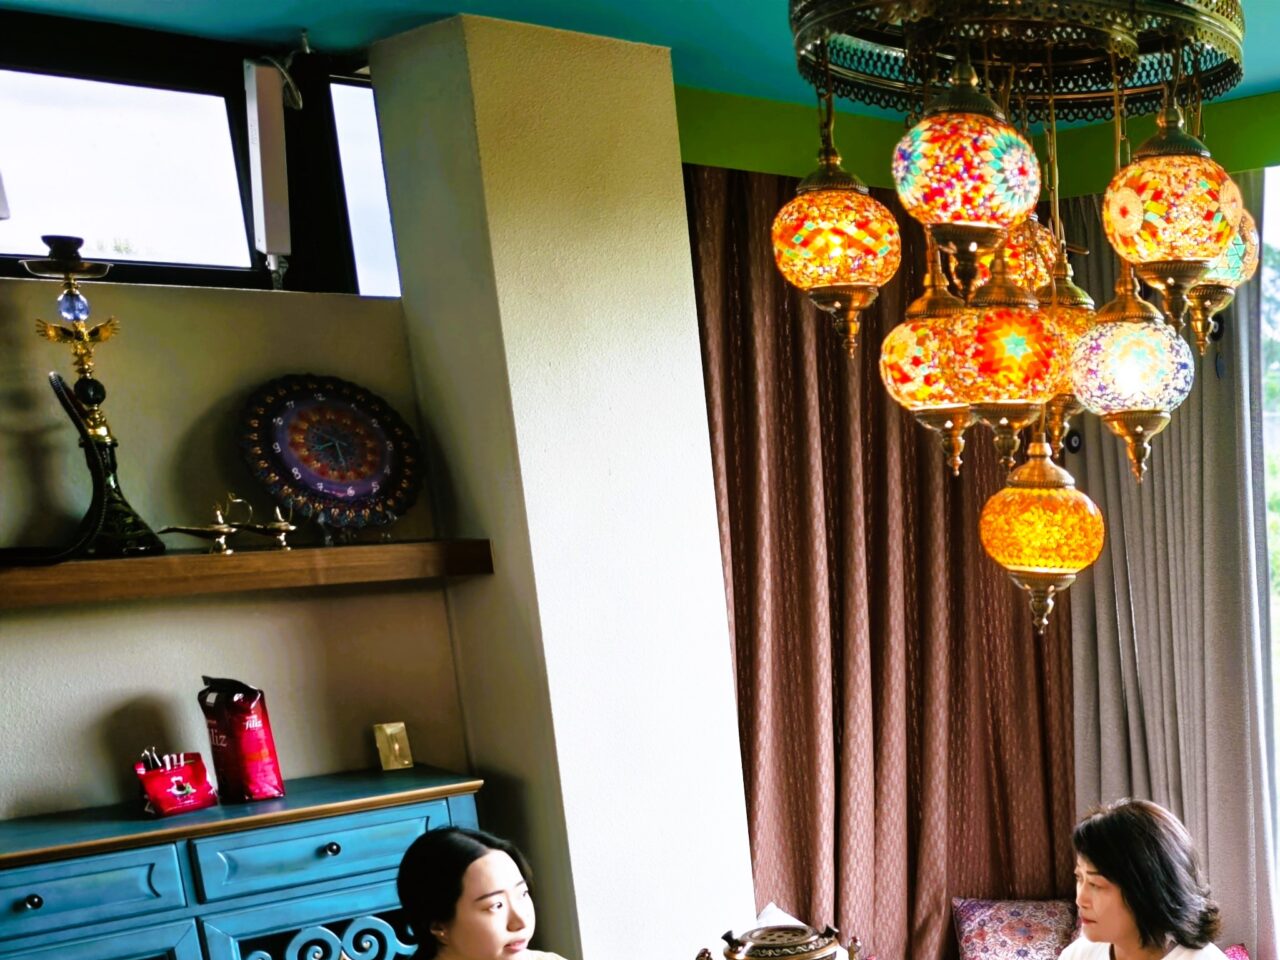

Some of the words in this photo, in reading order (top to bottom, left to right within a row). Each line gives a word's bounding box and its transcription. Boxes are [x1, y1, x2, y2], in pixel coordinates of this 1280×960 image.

[272, 416, 284, 426] 10
[272, 443, 282, 454] 9
[291, 467, 302, 480] 8
[316, 482, 324, 492] 7
[346, 486, 356, 497] 6
[371, 482, 380, 493] 5
[209, 728, 228, 747] liz
